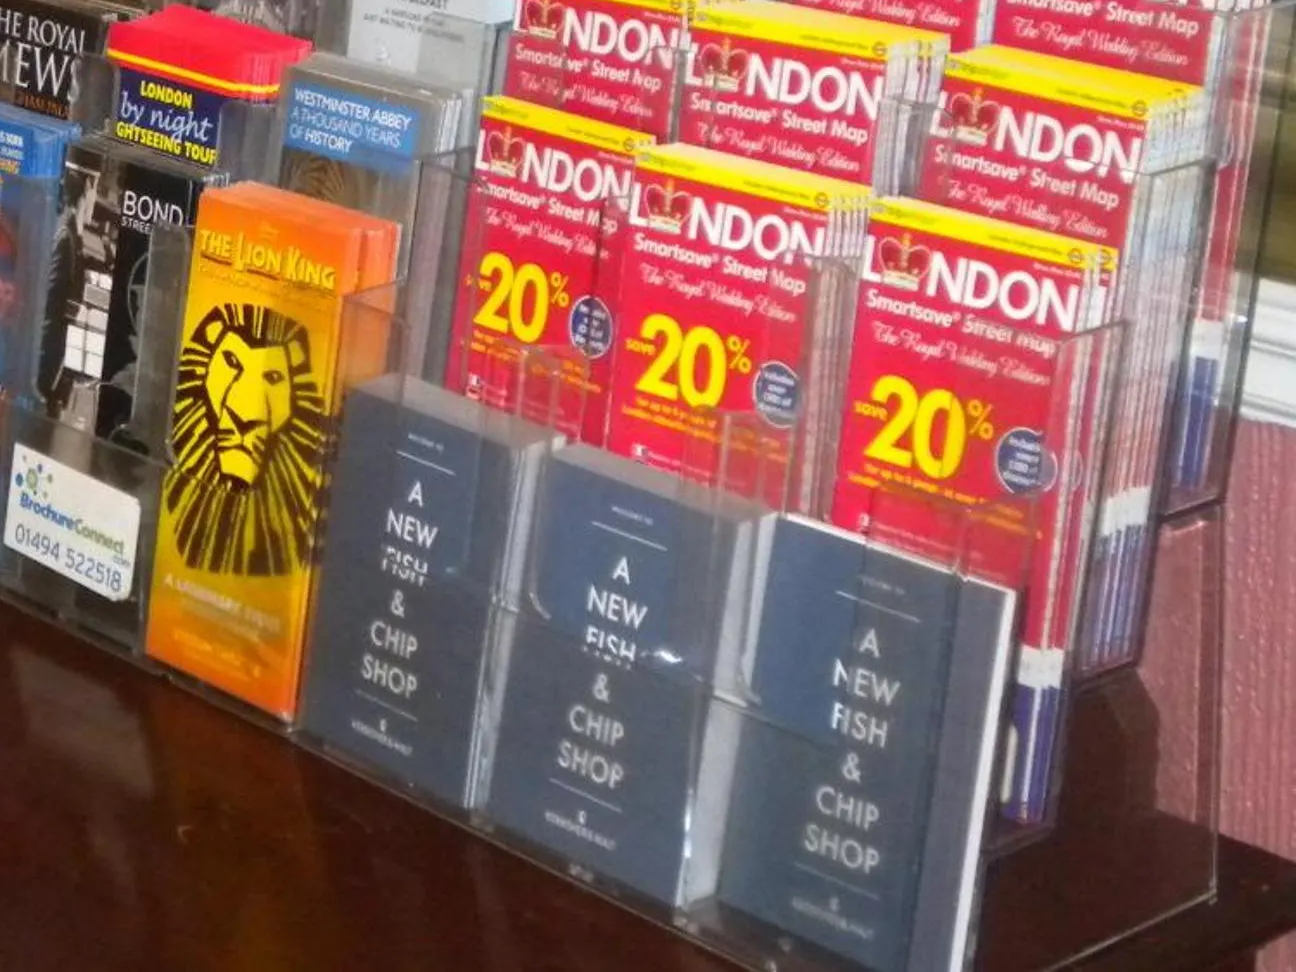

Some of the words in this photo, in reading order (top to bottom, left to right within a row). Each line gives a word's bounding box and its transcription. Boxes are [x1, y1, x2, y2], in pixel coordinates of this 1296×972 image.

[1106, 4, 1154, 27] Street
[1158, 9, 1200, 40] Map
[592, 59, 630, 83] Street
[140, 79, 193, 110] LONDON
[294, 87, 371, 122] WESTMINSTER
[371, 108, 413, 131] ABBEY
[118, 92, 145, 128] by
[150, 103, 213, 144] night
[782, 109, 828, 136] Street
[304, 128, 353, 154] HISTORY
[1030, 166, 1077, 196] Street
[122, 188, 184, 227] BOND
[548, 199, 585, 224] Street
[200, 228, 232, 261] THE
[234, 230, 281, 271] LION
[284, 250, 337, 287] KING
[722, 254, 770, 286] Street
[771, 267, 806, 296] Map
[473, 251, 570, 344] 20%
[962, 314, 1013, 345] Street
[635, 313, 752, 410] 20%
[863, 374, 994, 479] 20%
[407, 481, 424, 508] A
[17, 491, 126, 556] BrochureConnect
[385, 508, 439, 549] NEW
[14, 521, 61, 566] 01494
[64, 546, 123, 595] 522518
[612, 556, 631, 585] A
[390, 590, 406, 617] &
[586, 585, 648, 630] NEW
[369, 621, 419, 660] CHIP
[858, 628, 882, 658] A
[361, 654, 419, 700] SHOP
[591, 673, 609, 703] &
[832, 658, 901, 707] NEW
[568, 704, 626, 749] CHIP
[830, 701, 889, 750] FISH
[556, 741, 625, 791] SHOP
[842, 752, 862, 784] &
[815, 785, 881, 831] CHIP
[802, 824, 882, 875] SHOP
